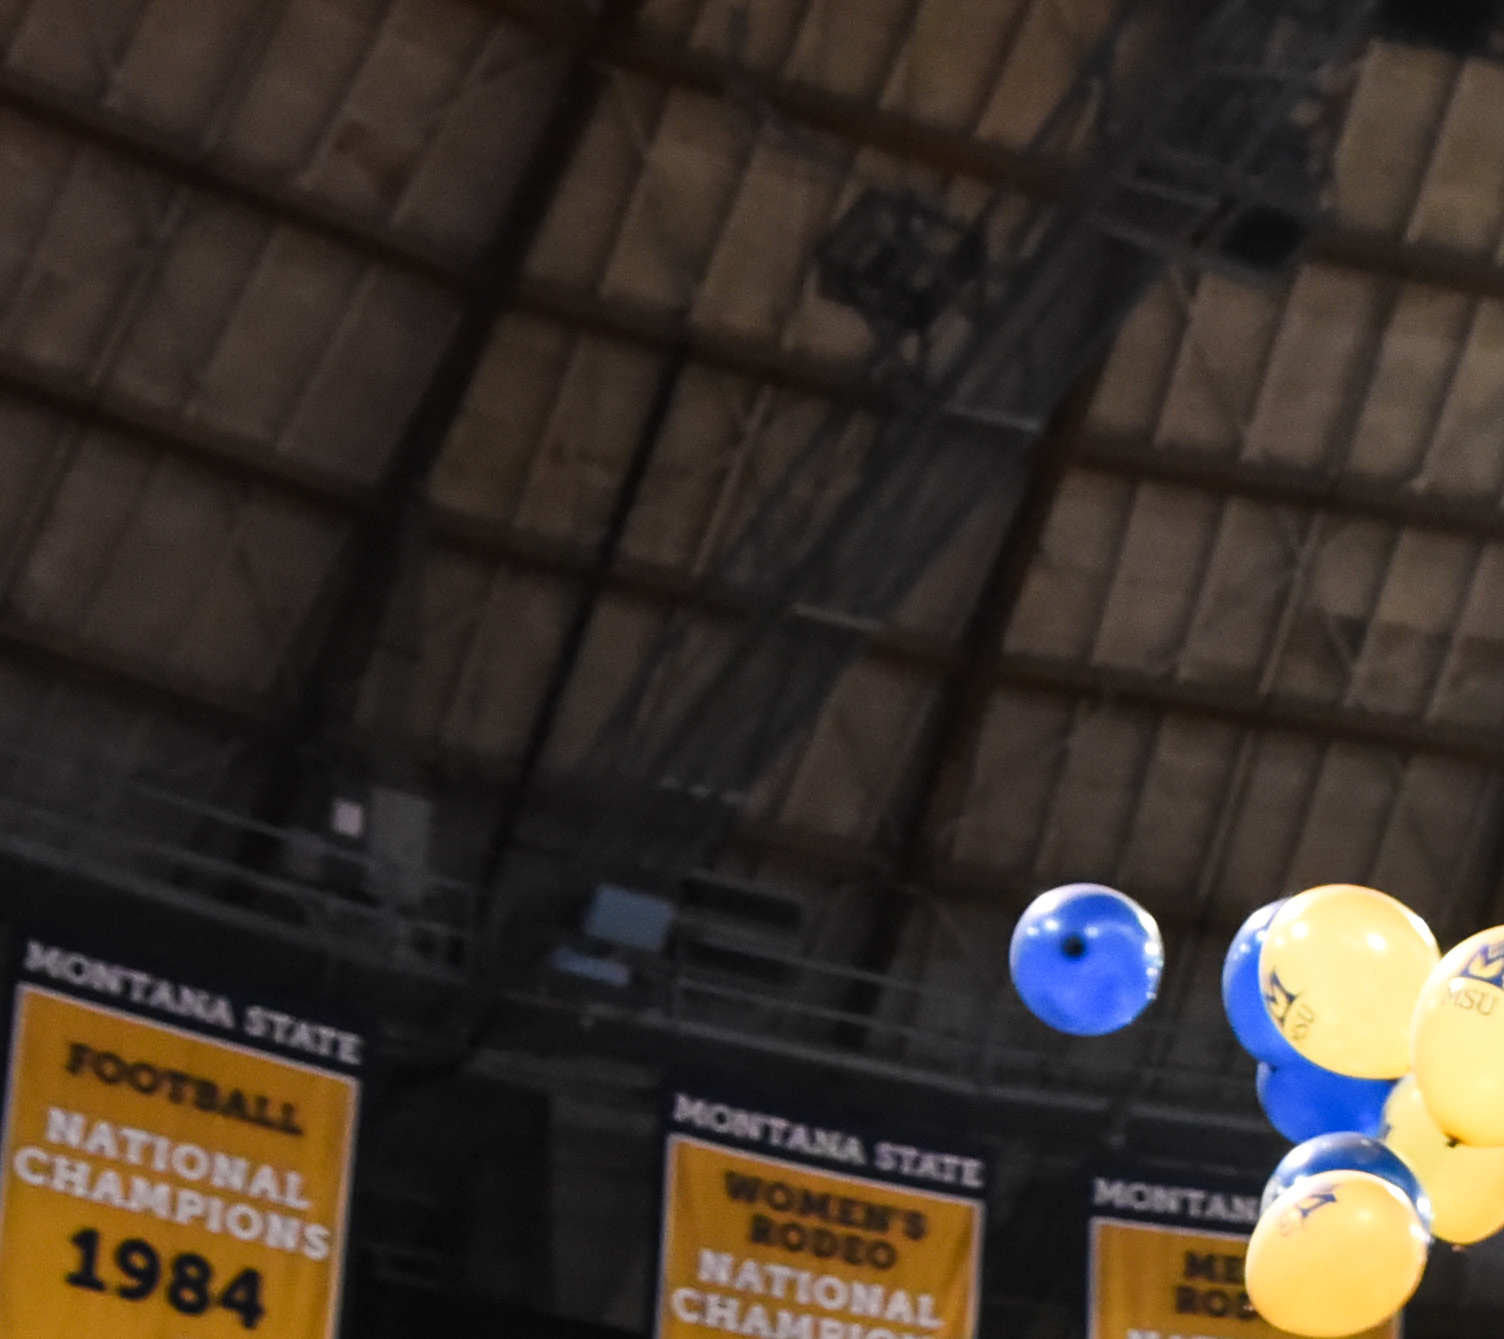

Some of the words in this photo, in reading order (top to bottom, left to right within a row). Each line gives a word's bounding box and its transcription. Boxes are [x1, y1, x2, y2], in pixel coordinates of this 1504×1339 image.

[22, 938, 236, 1031] MONTANA
[243, 1004, 363, 1066] STATE
[62, 1041, 304, 1137] FOOTBALL
[45, 1106, 311, 1211] NATIONAL
[672, 1091, 866, 1166] MONTANA
[873, 1140, 984, 1189] STATE
[13, 1146, 331, 1261] CHAMPIONS
[749, 1211, 897, 1271] RODEO
[1093, 1176, 1262, 1223] MONTAN
[65, 1225, 266, 1331] 1984
[697, 1249, 945, 1330] NATIONAL
